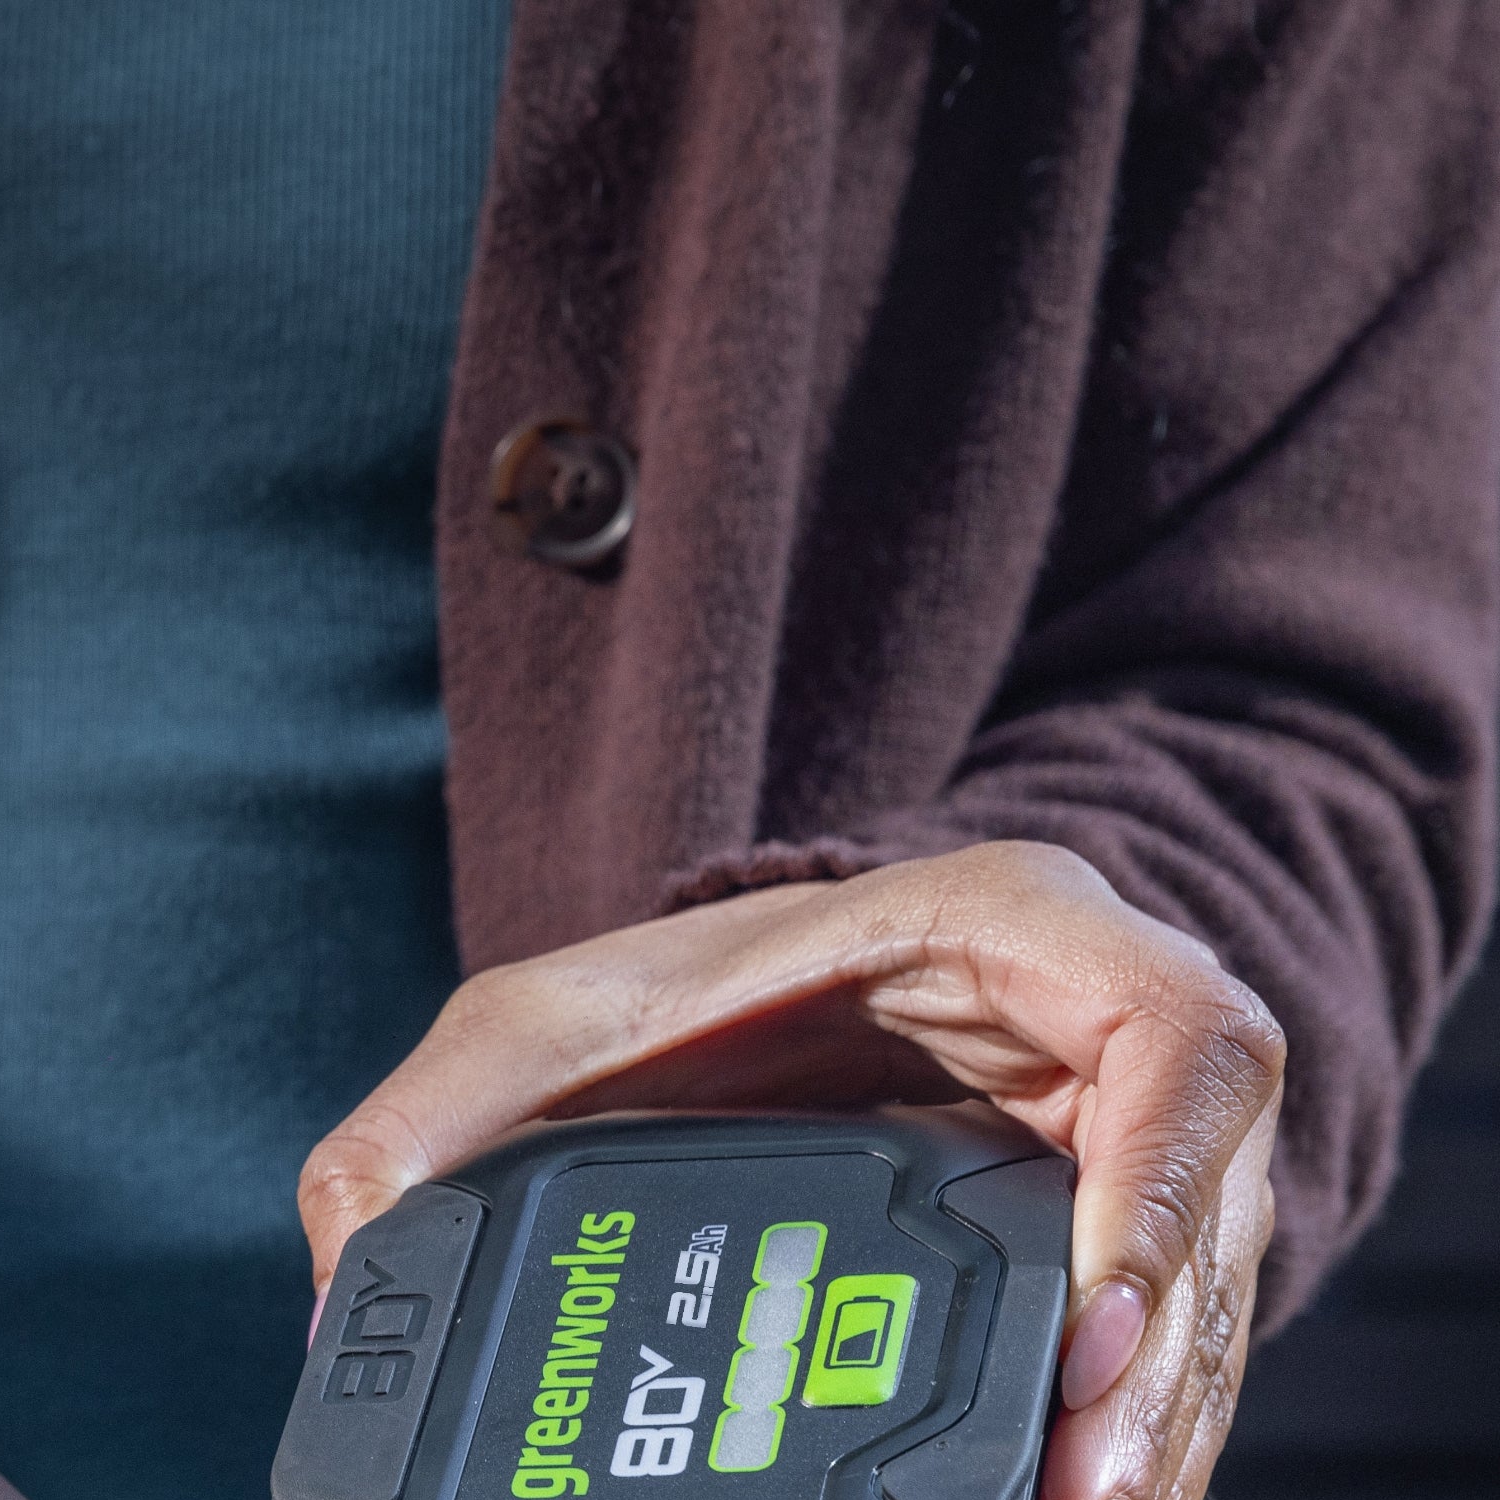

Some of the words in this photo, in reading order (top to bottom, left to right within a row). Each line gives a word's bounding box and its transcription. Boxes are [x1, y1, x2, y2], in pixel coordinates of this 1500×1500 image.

[321, 1257, 434, 1403] 80V
[511, 1210, 636, 1499] greenworks
[609, 1344, 706, 1478] 80V
